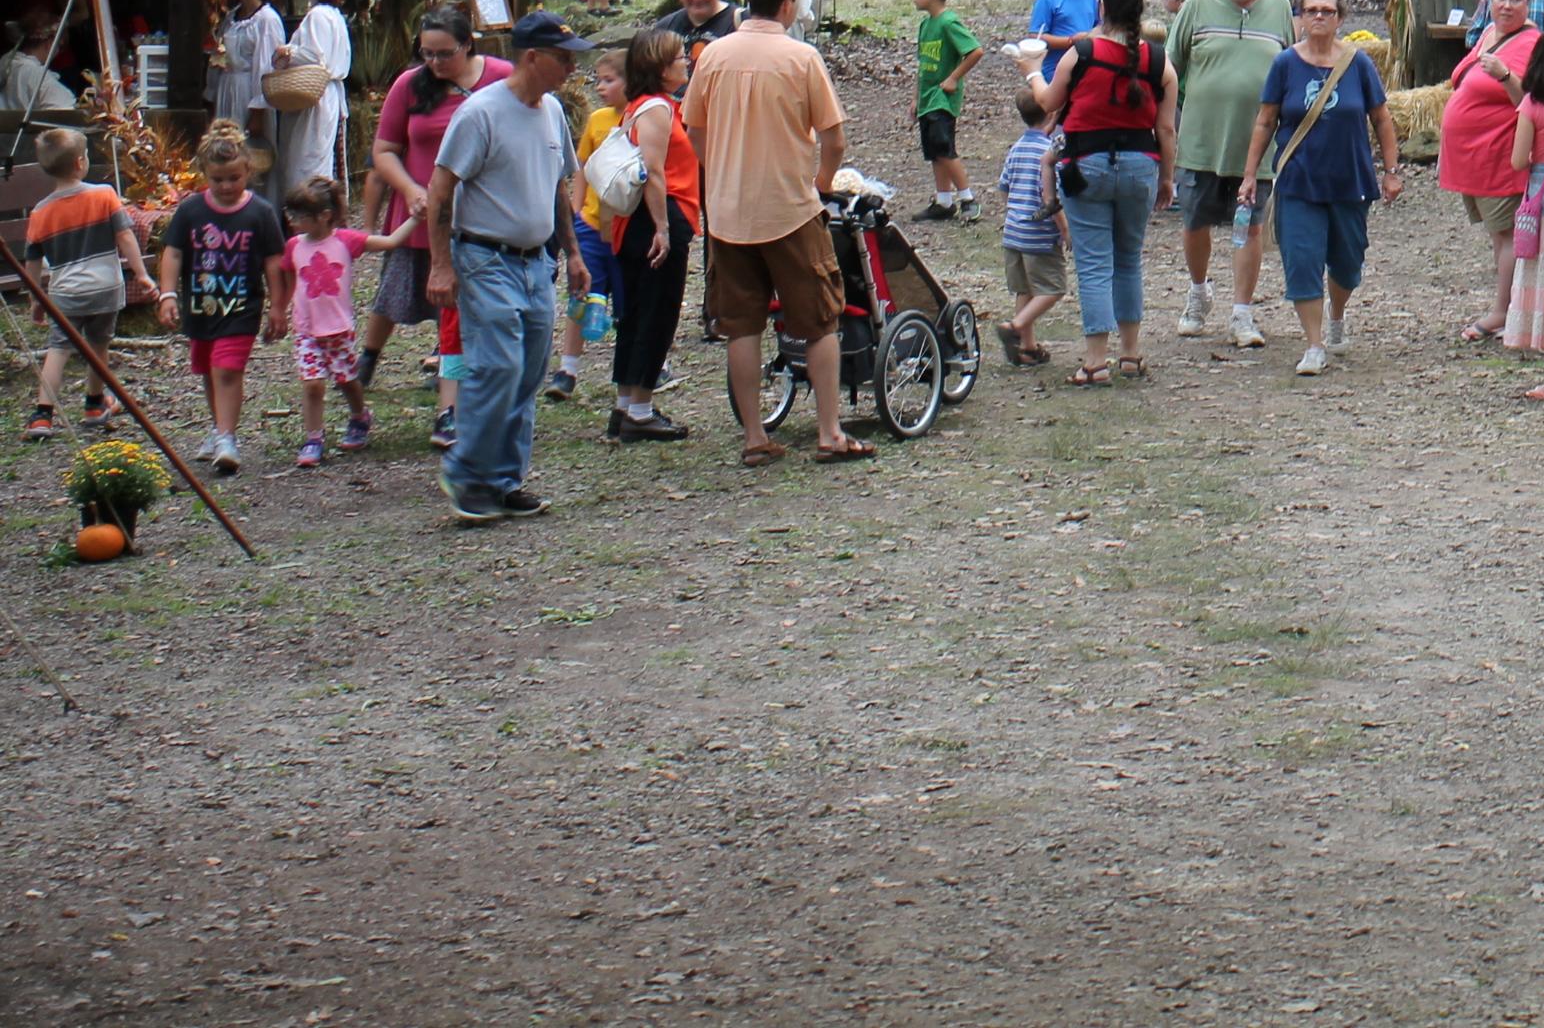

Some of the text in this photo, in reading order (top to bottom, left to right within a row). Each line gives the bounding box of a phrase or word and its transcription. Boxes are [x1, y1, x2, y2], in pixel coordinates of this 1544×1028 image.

[191, 222, 253, 250] LOVE
[193, 251, 249, 272] LOVE
[191, 273, 247, 294] LOVE
[191, 295, 246, 316] LOVE
